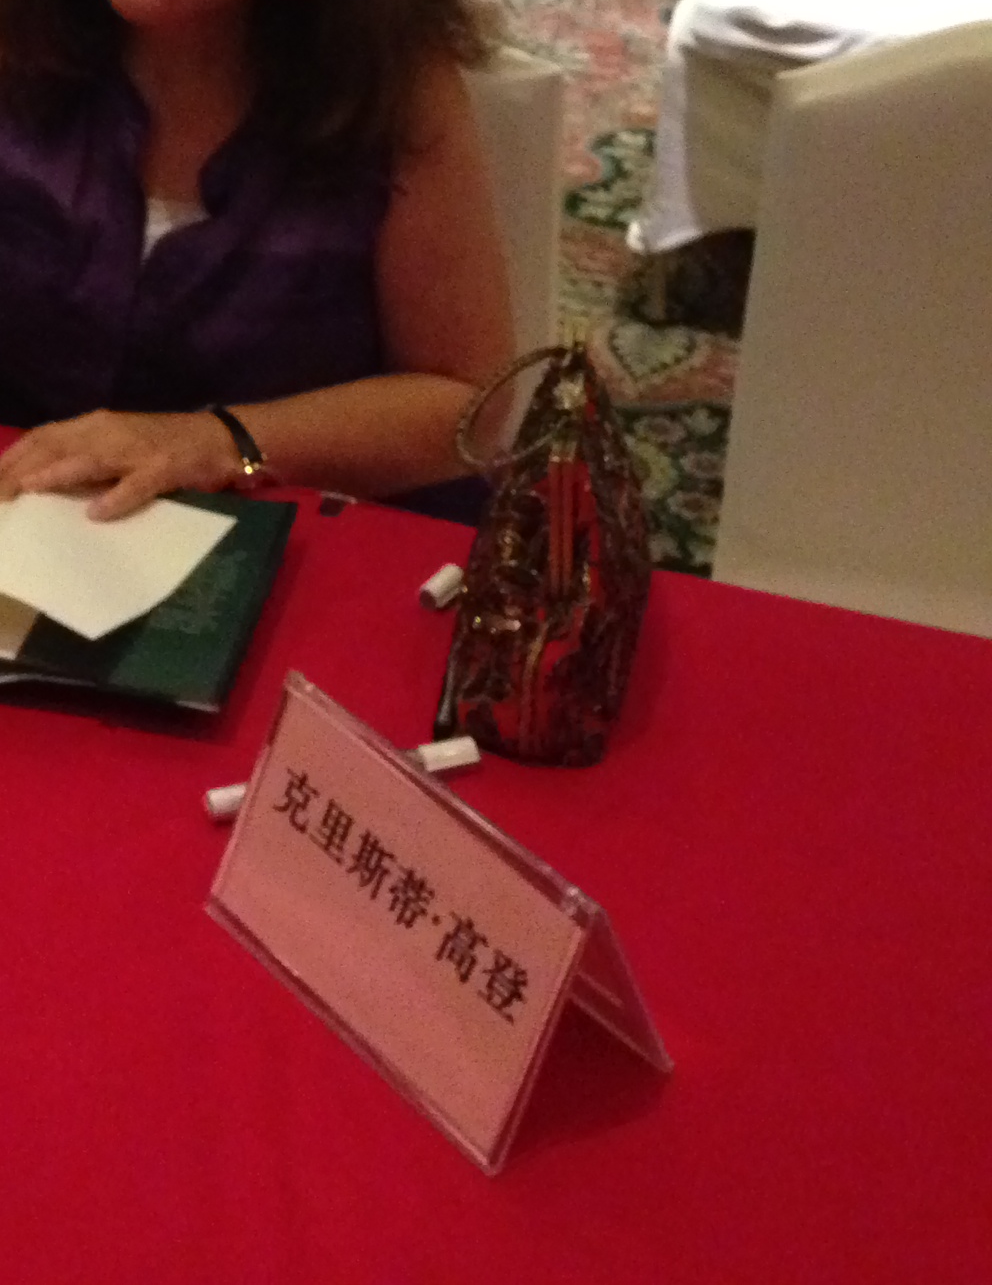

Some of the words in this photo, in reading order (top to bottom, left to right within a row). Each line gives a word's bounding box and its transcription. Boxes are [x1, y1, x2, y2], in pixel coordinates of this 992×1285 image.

[273, 768, 529, 1023] 克里斯蒂·高登
